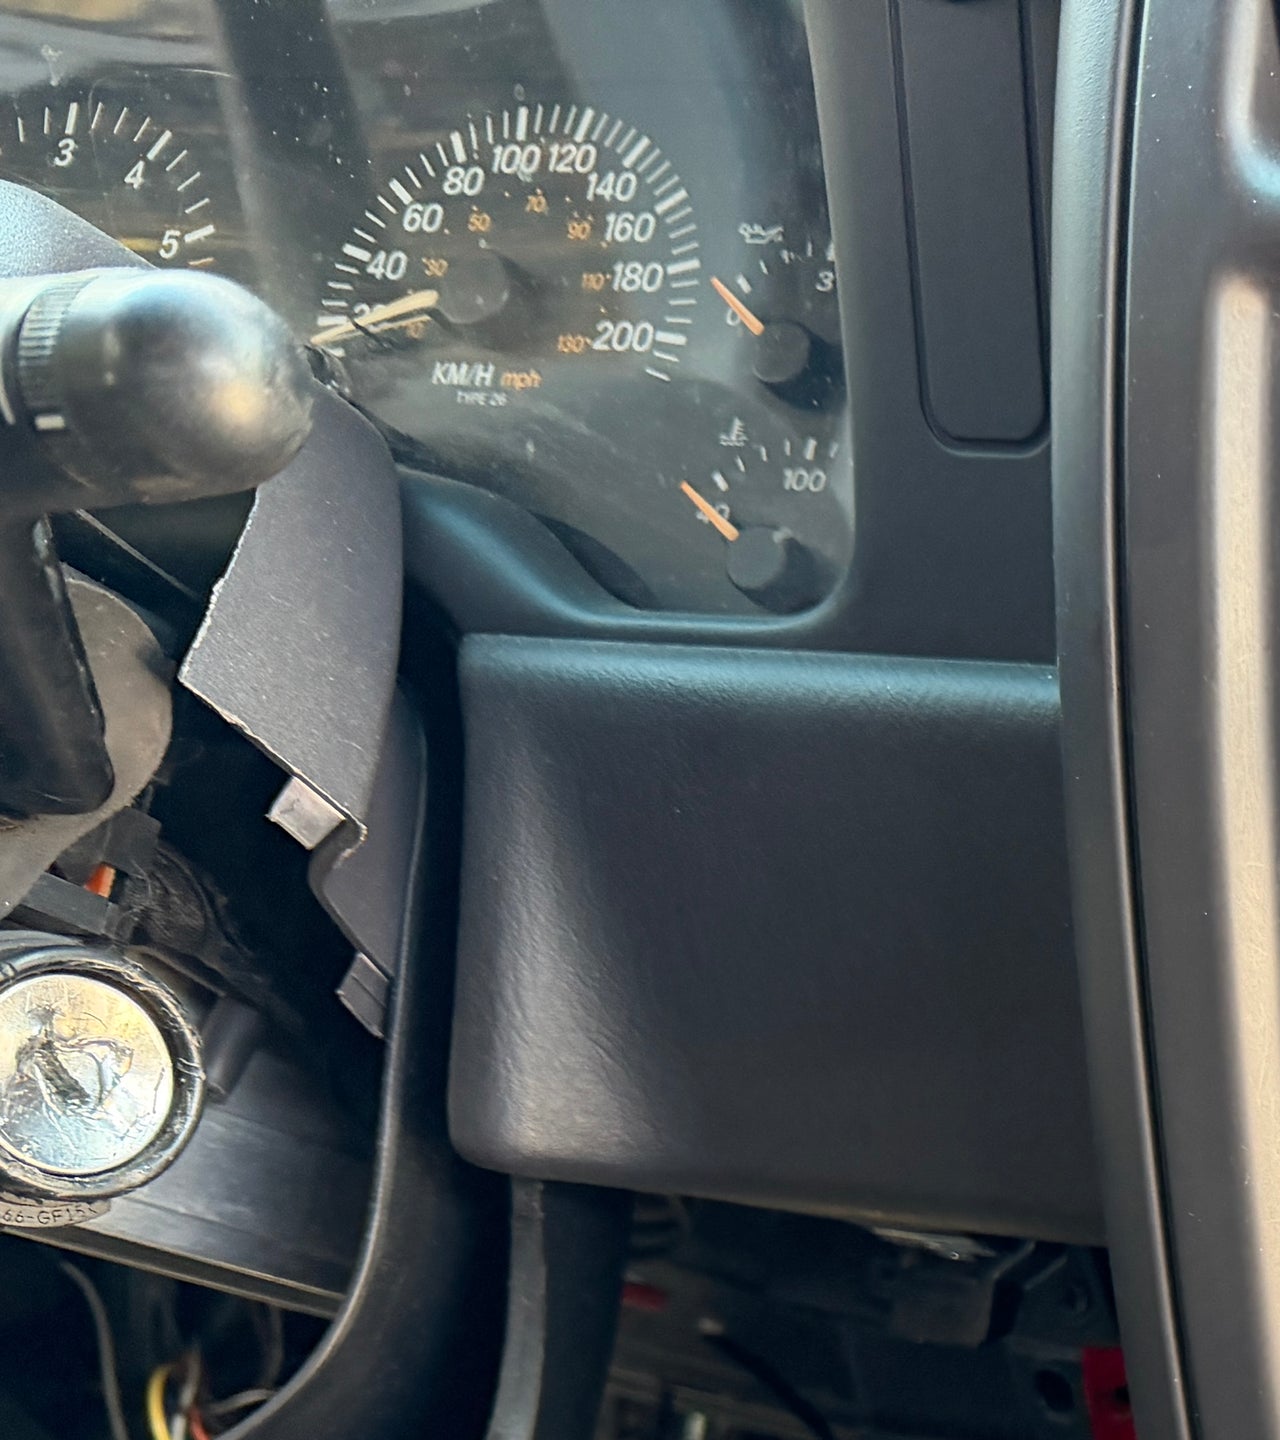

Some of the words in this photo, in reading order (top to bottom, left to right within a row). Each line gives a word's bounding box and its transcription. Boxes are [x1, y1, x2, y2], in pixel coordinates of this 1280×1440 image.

[54, 138, 75, 167] 3
[491, 144, 541, 174] 100
[548, 144, 597, 173] 120
[123, 160, 145, 190] 4
[443, 167, 485, 196] 80
[587, 171, 638, 202] 140
[403, 204, 443, 233] 60
[605, 212, 656, 242] 160
[159, 229, 181, 260] 5
[366, 251, 408, 281] 40
[612, 262, 664, 292] 180
[592, 321, 654, 352] 200
[432, 361, 495, 387] KM/H
[501, 369, 543, 391] mph
[783, 468, 826, 492] 100
